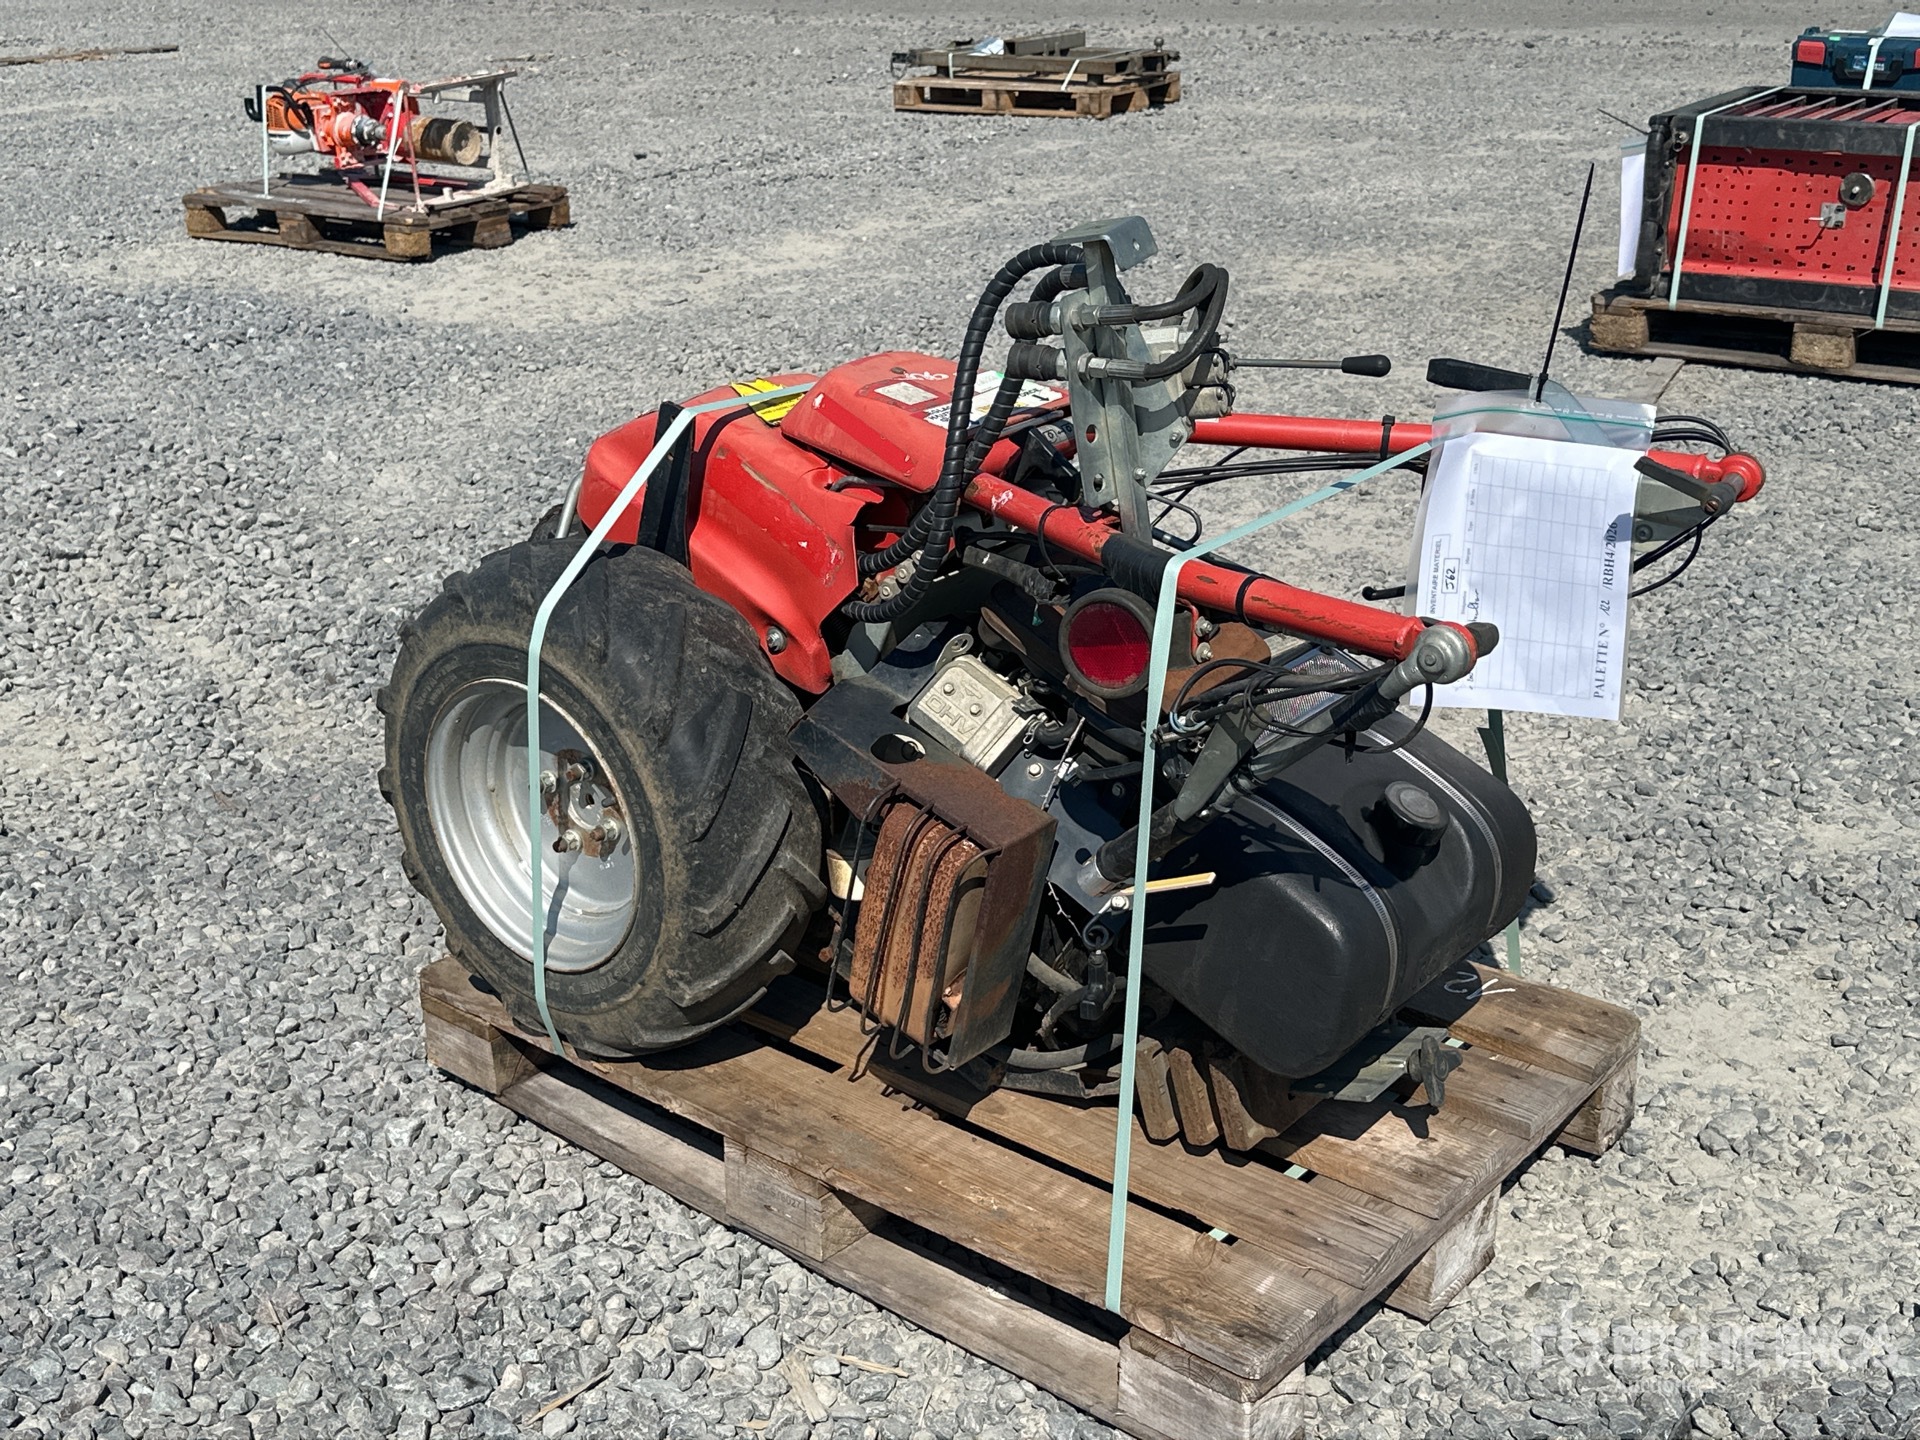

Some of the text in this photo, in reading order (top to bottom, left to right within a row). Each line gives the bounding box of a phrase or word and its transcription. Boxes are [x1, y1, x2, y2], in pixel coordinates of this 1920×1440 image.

[1430, 538, 1443, 615] INVENTAIRE MATERIEL
[1602, 521, 1619, 591] /RBH4/2026
[1598, 622, 1610, 638] N°
[1593, 640, 1609, 699] PALETTE
[925, 694, 977, 736] OHV
